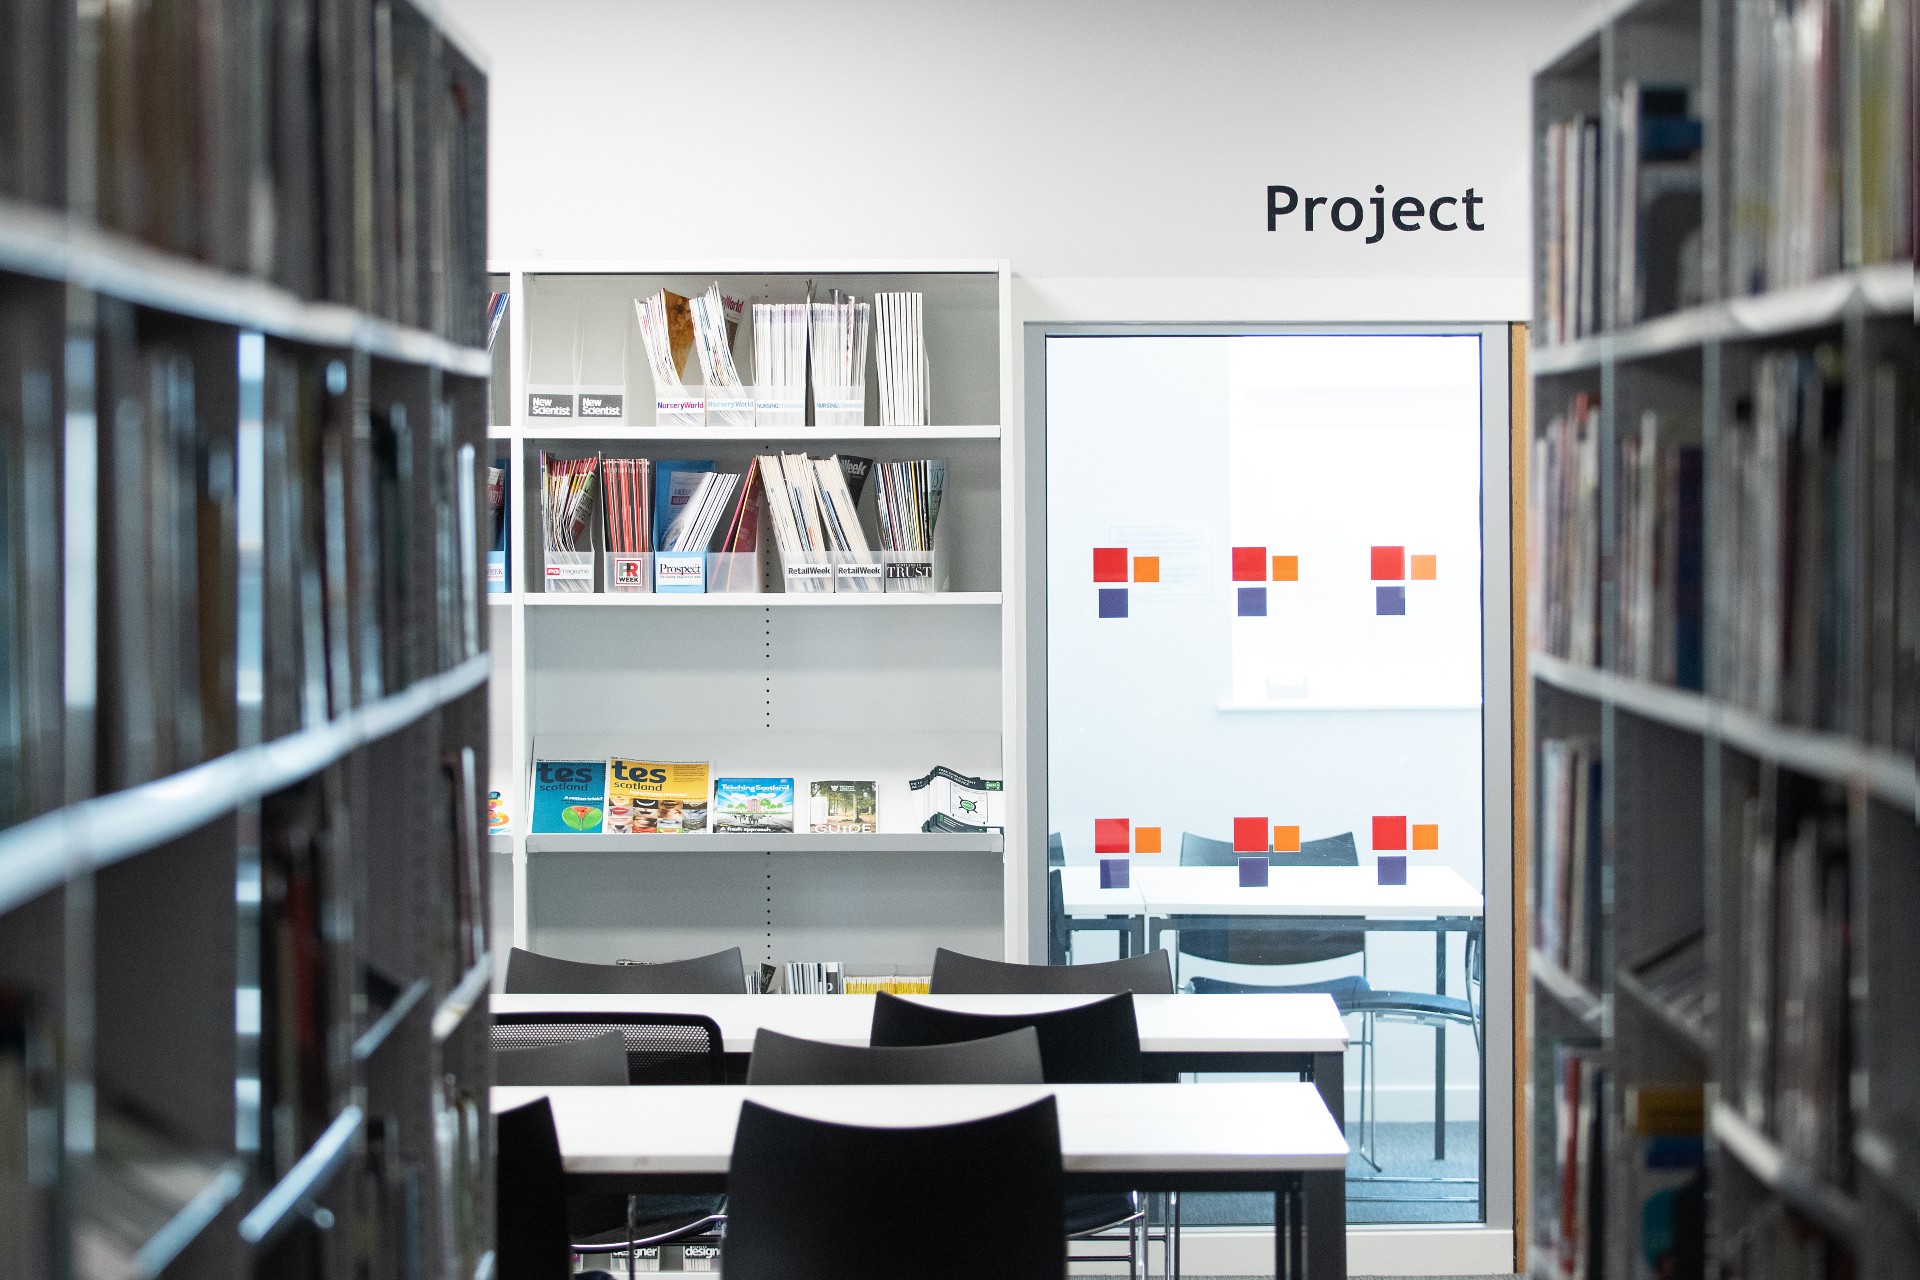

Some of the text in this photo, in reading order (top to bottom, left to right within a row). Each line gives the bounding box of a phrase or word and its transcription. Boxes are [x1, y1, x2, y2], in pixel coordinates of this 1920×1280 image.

[1267, 184, 1485, 244] Project
[532, 397, 552, 406] New
[582, 397, 602, 406] New
[657, 401, 704, 410] NurseryWorld
[707, 400, 754, 409] NurseryWorld
[532, 406, 571, 415] Scientist
[582, 406, 621, 415] Scientist
[487, 566, 503, 576] EEK
[618, 562, 639, 577] PR
[659, 563, 701, 576] Prospect
[788, 566, 830, 575] RetailWeek
[838, 566, 880, 575] RetailWeek
[886, 566, 932, 578] TRUST
[537, 762, 593, 784] tes
[611, 760, 667, 784] tes
[539, 782, 589, 792] scotland
[614, 781, 663, 792] scotland
[721, 784, 755, 792] Teaching
[685, 1246, 722, 1259] design
